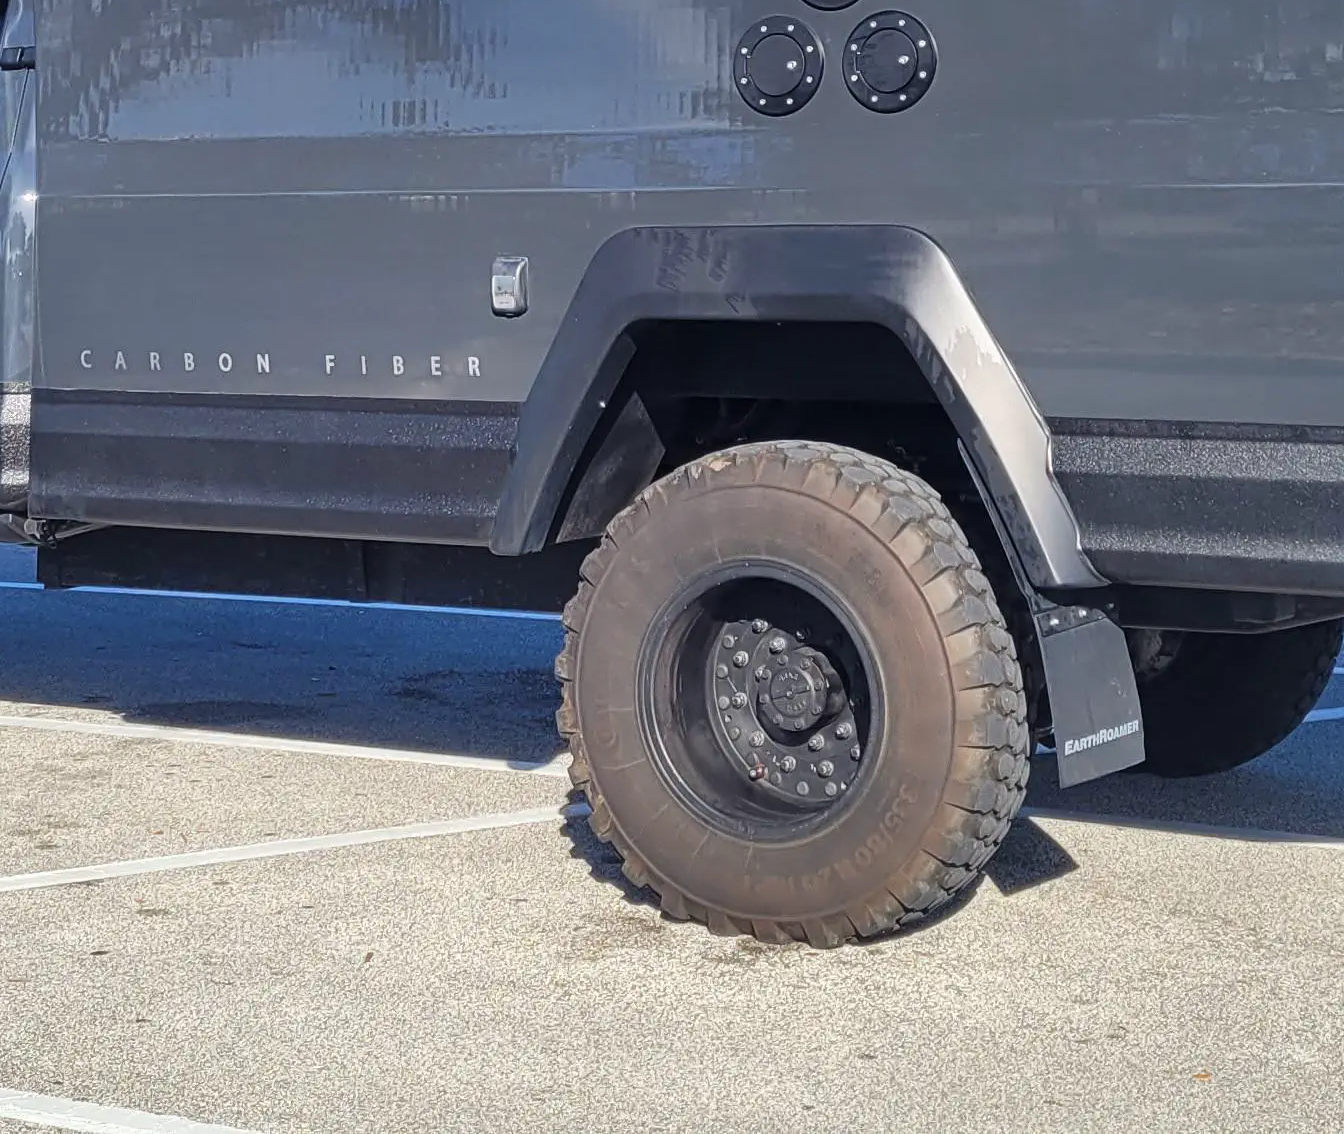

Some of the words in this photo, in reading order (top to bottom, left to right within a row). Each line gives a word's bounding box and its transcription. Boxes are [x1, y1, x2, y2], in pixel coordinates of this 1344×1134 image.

[80, 349, 271, 373] CARBON
[325, 354, 482, 378] FIBER
[1064, 719, 1140, 756] EARTHROAMER
